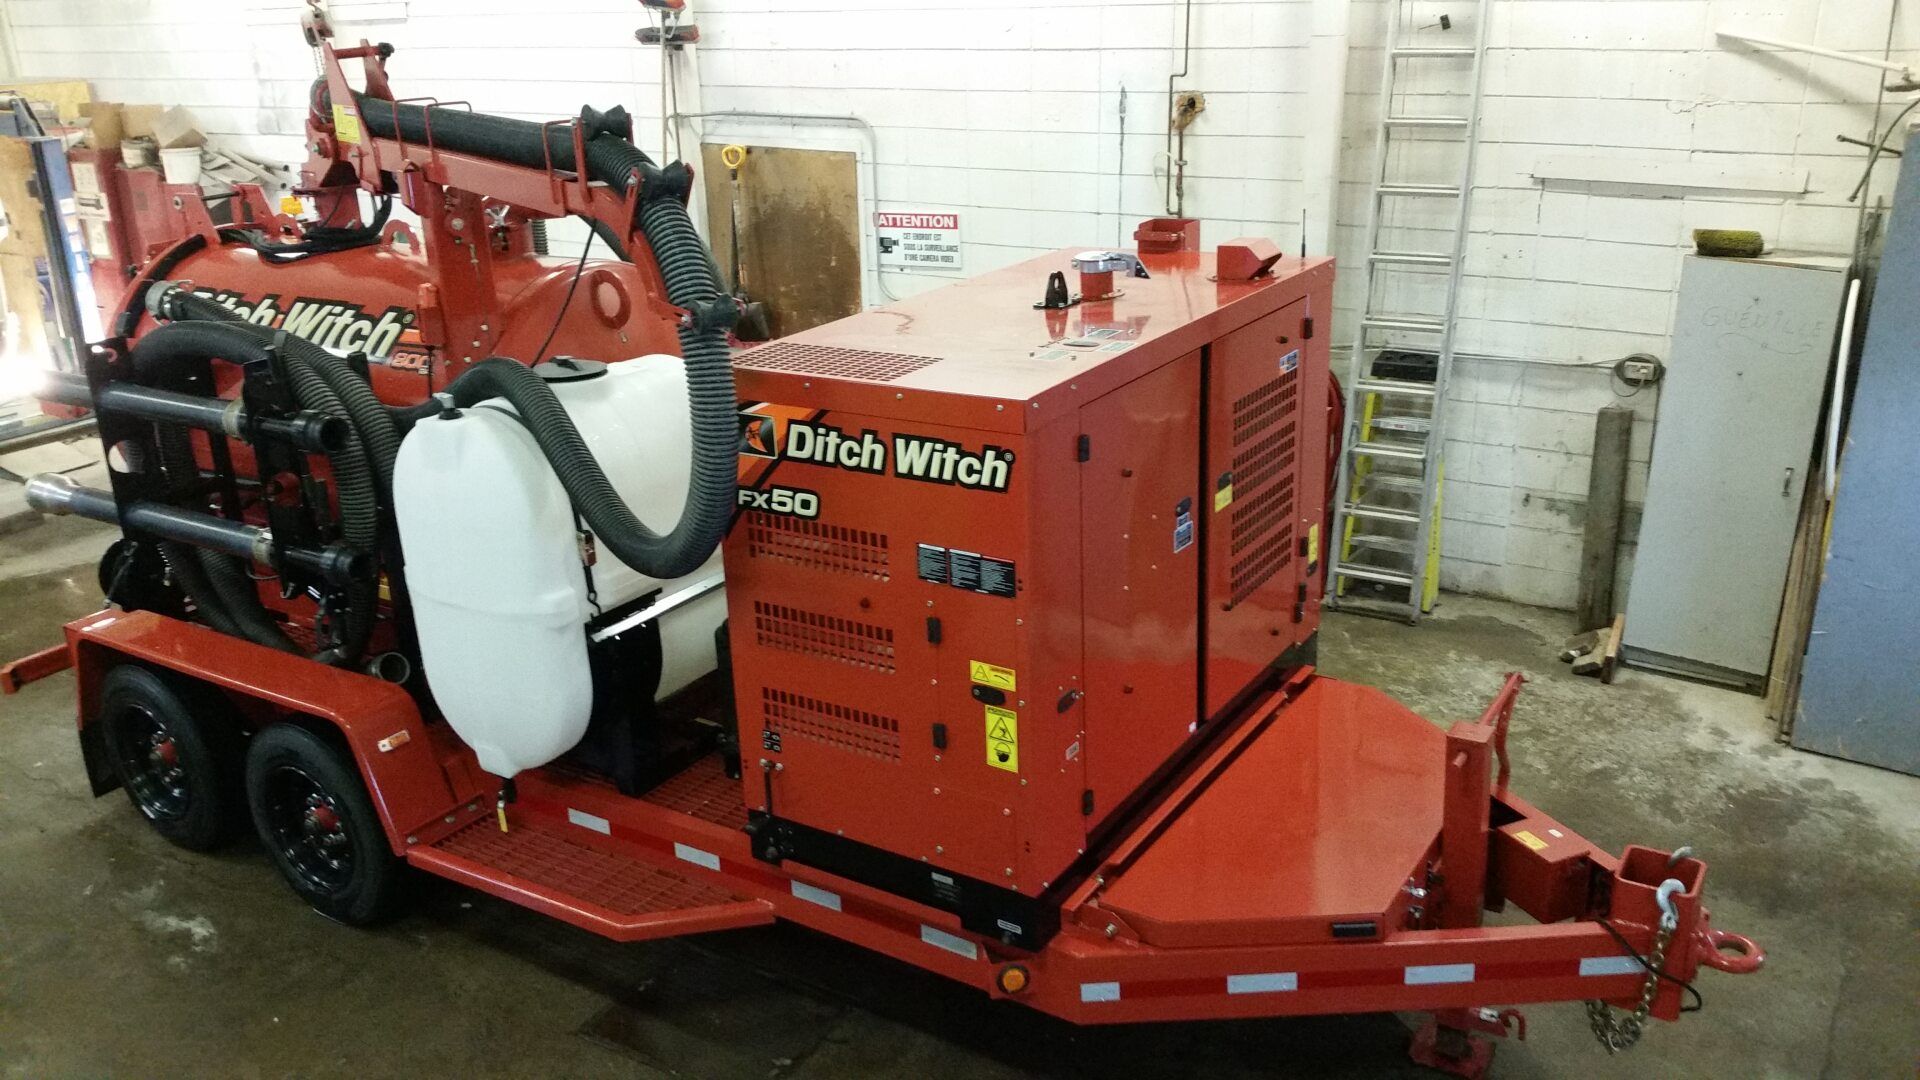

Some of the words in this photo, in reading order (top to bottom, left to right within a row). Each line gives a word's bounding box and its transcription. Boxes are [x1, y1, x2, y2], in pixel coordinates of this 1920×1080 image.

[879, 214, 955, 228] ATTENTION
[924, 244, 959, 252] SURVEILLANCE
[283, 301, 402, 359] Witch
[787, 423, 885, 471] Ditch
[895, 436, 1009, 489] Witch
[738, 488, 819, 517] FX50
